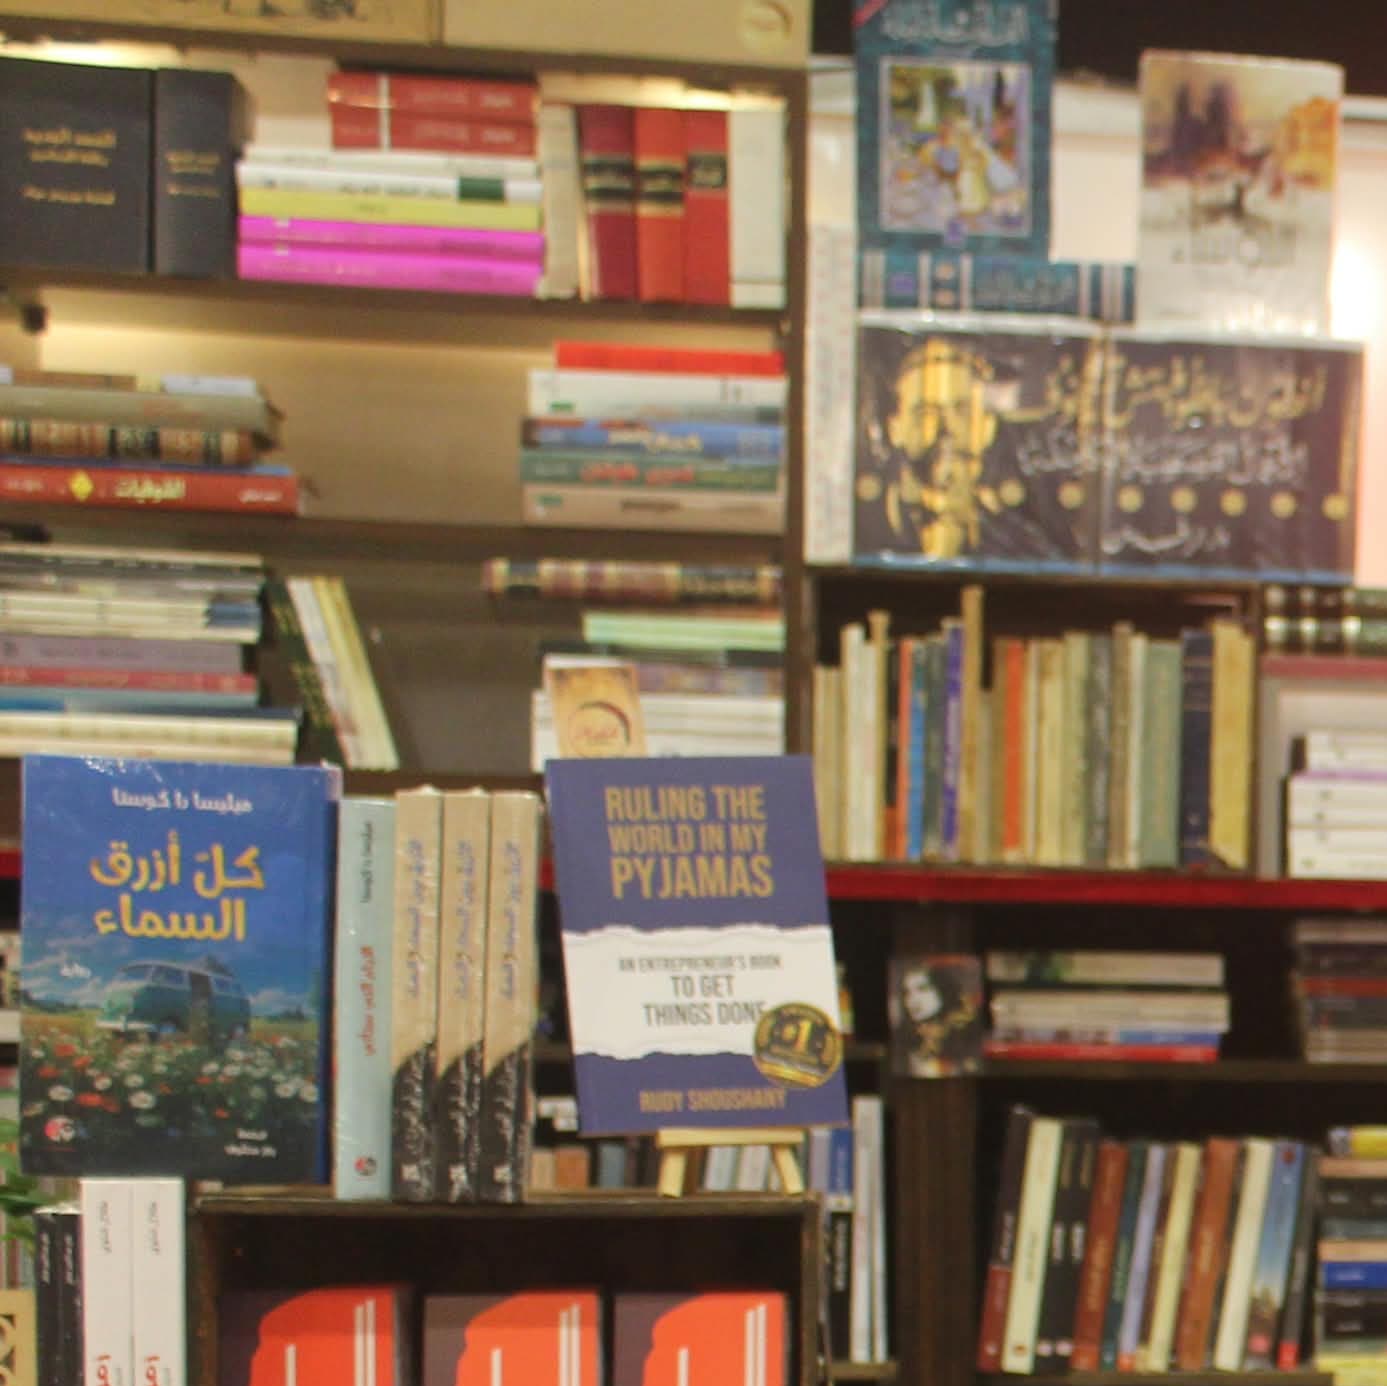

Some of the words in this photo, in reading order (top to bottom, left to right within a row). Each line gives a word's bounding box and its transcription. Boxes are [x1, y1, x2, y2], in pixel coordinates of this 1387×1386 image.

[605, 786, 705, 820] RULING
[712, 786, 767, 820] THE
[609, 824, 692, 854] WORLD
[700, 824, 725, 852] IN
[731, 823, 767, 852] MY
[90, 830, 181, 892] أزرق
[611, 856, 774, 899] PYJAMAS
[94, 895, 245, 941] السماء
[671, 976, 694, 997] TO
[700, 975, 734, 997] GET
[644, 1003, 710, 1026] THINGS
[639, 1089, 683, 1112] RUDY
